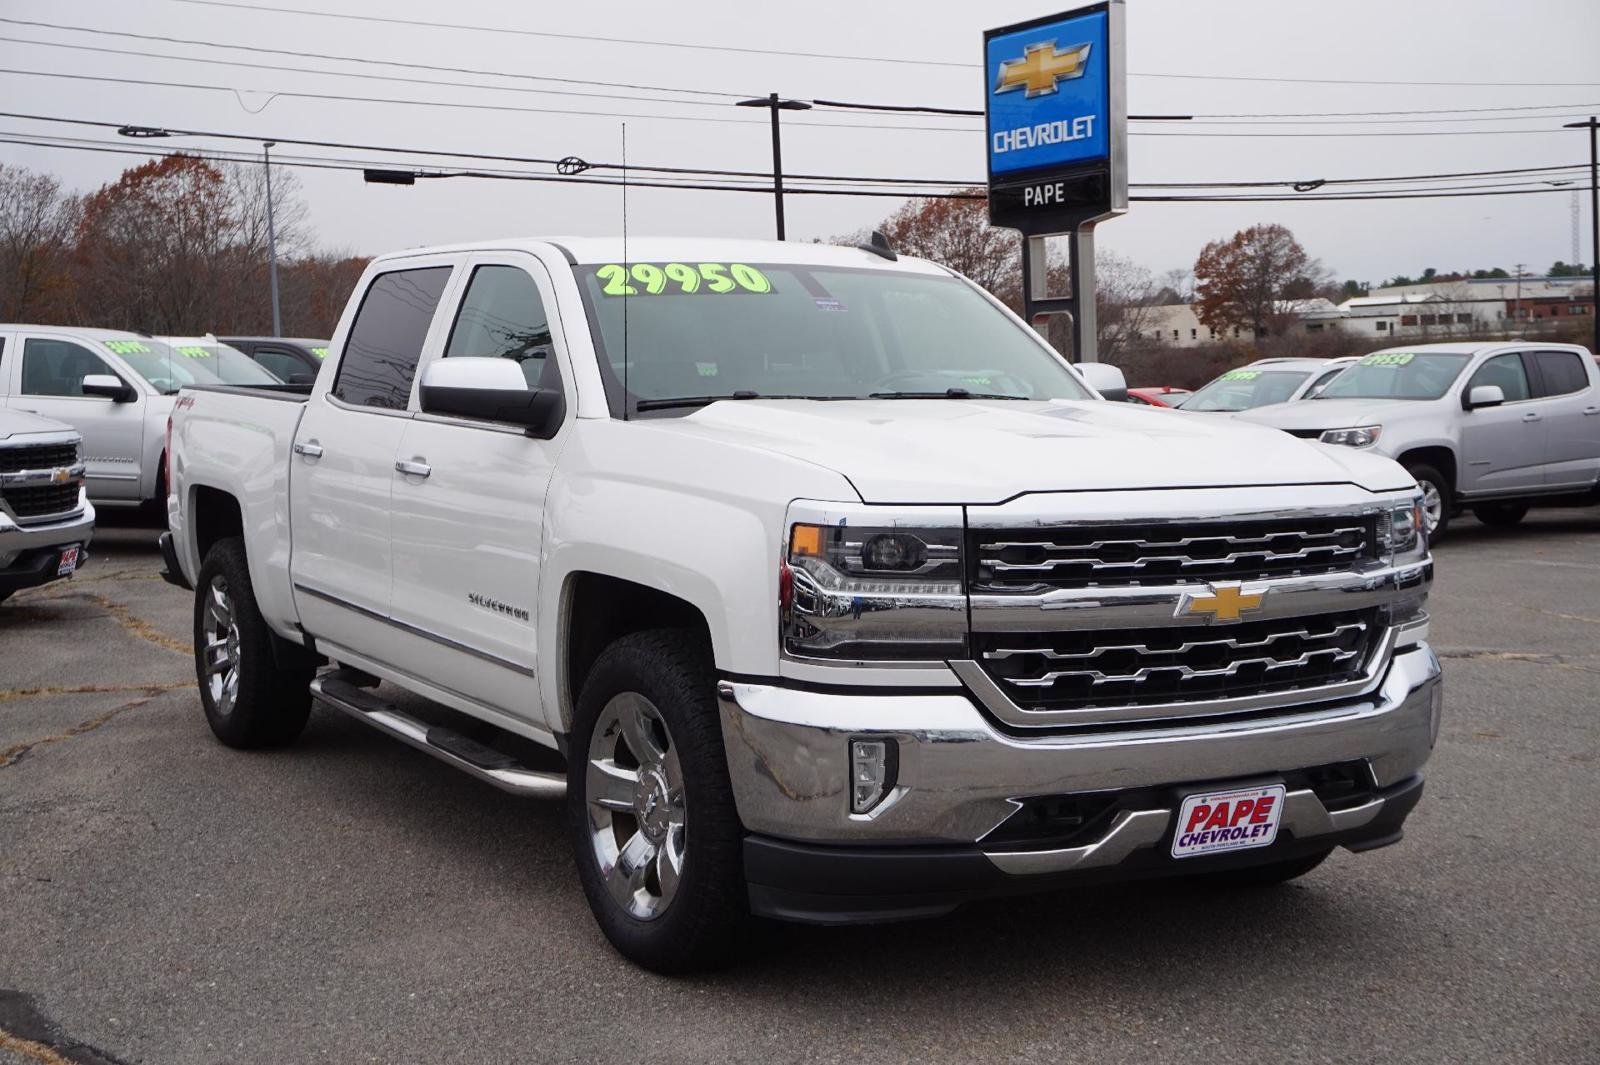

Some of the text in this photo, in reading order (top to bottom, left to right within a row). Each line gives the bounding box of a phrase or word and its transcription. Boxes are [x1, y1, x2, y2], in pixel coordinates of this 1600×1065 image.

[993, 115, 1096, 153] CHEVROLET
[1025, 183, 1065, 206] PAPE
[596, 263, 771, 295] 29950
[1185, 796, 1276, 833] PAPE
[1179, 823, 1273, 848] CHEVROLET
